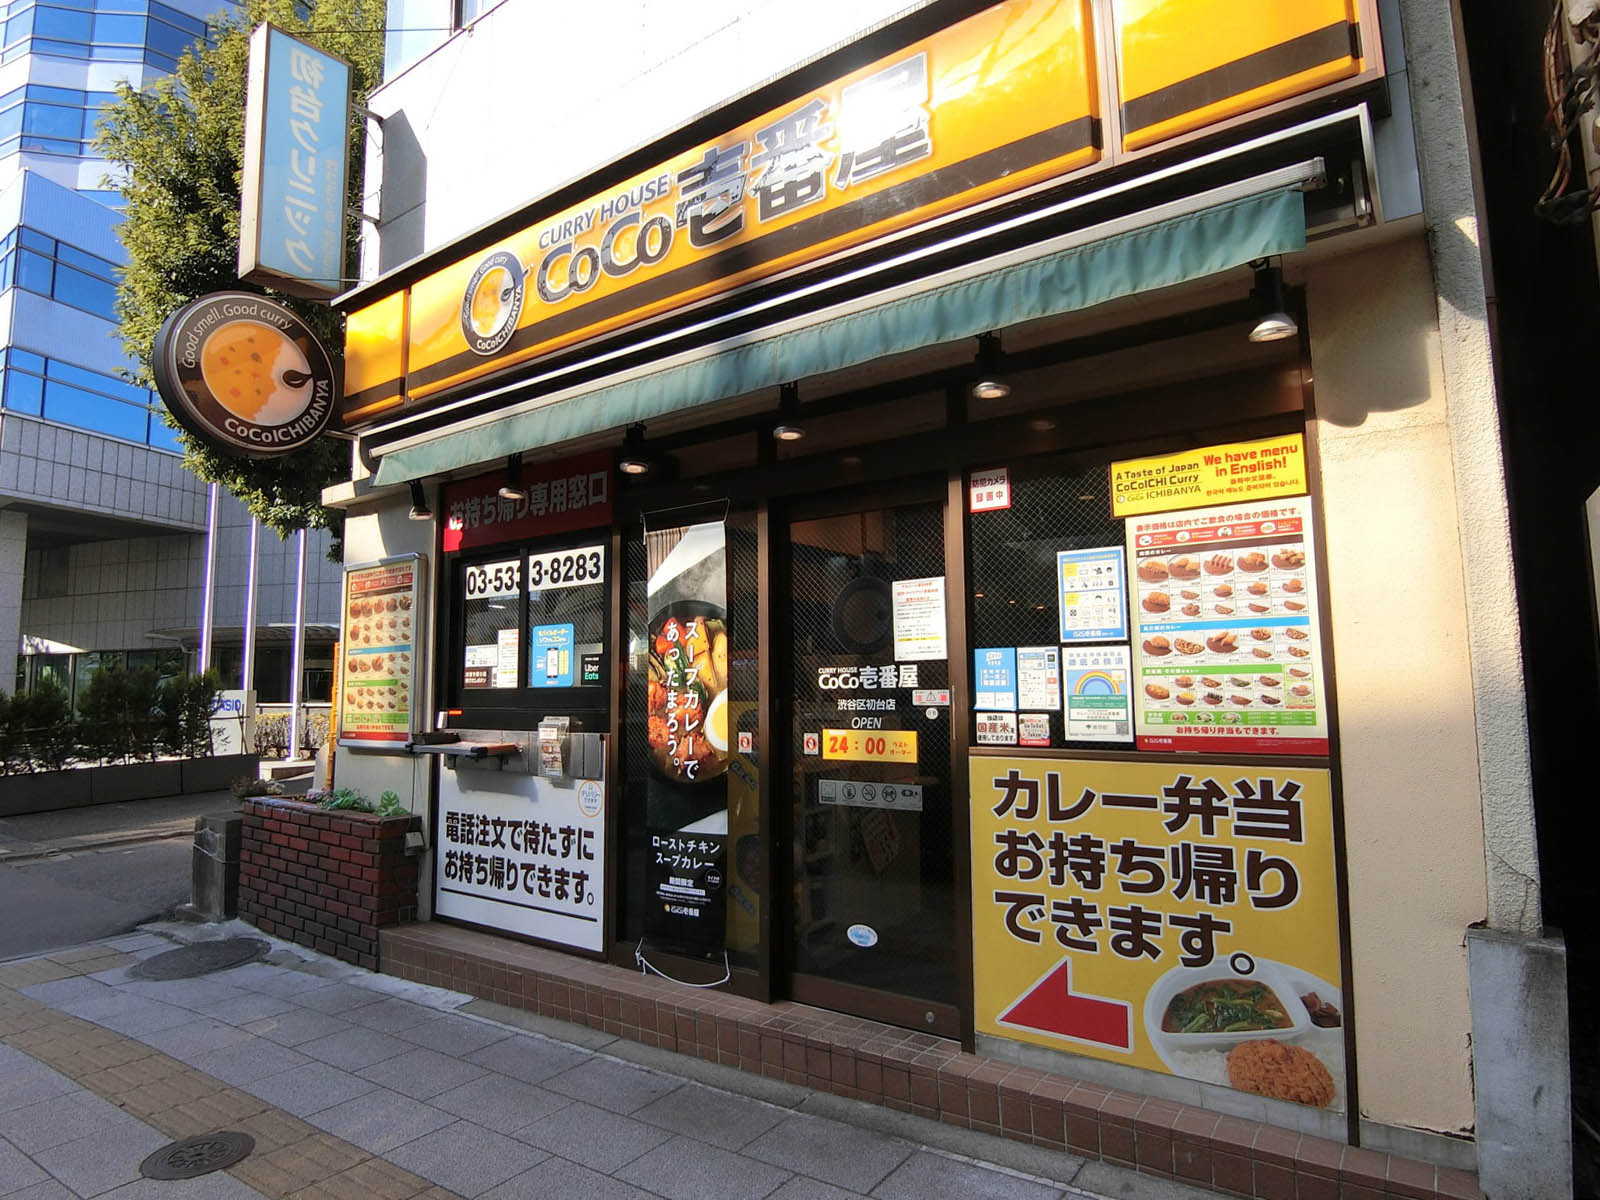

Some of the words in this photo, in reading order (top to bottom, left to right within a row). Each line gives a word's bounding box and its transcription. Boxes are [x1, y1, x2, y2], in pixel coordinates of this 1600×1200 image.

[539, 208, 596, 249] CURRY
[599, 173, 670, 224] HOUSE
[476, 285, 522, 350] CoCoICHIBANYA
[183, 332, 198, 369] Good
[223, 304, 258, 316] Good
[260, 309, 292, 330] curry
[224, 379, 329, 443] CoCoICHIBANYA
[1116, 472, 1122, 480] A
[1125, 468, 1153, 479] Taste
[1155, 466, 1165, 475] of
[1169, 463, 1199, 473] Japan
[1204, 455, 1221, 466] We
[1225, 450, 1257, 463] have
[1260, 444, 1298, 457] menu
[1216, 466, 1227, 477] in
[1230, 456, 1287, 475] English!
[972, 475, 1006, 488] 防犯カメラ
[1116, 477, 1167, 492] CoCoICHI
[1169, 474, 1199, 484] Curry
[1146, 485, 1201, 499] ICHIBANYA
[449, 471, 608, 530] お持ち帰り専用窓口
[531, 551, 601, 586] 3-8283
[584, 664, 600, 673] Uber
[584, 673, 599, 681] Eats
[665, 621, 680, 767] あったまろう。
[684, 621, 700, 780] スープカレーで
[837, 698, 896, 711] 渋谷区初台店
[851, 716, 882, 729] OPEN
[993, 770, 1304, 843] カレー弁当
[446, 811, 594, 861] 電話注文で待たずに
[652, 835, 720, 854] ローストチキン
[444, 849, 595, 906] お持ち帰りできます。
[656, 852, 715, 869] スープカレー
[993, 829, 1300, 910] お持ち帰り
[993, 891, 1256, 976] できます。
